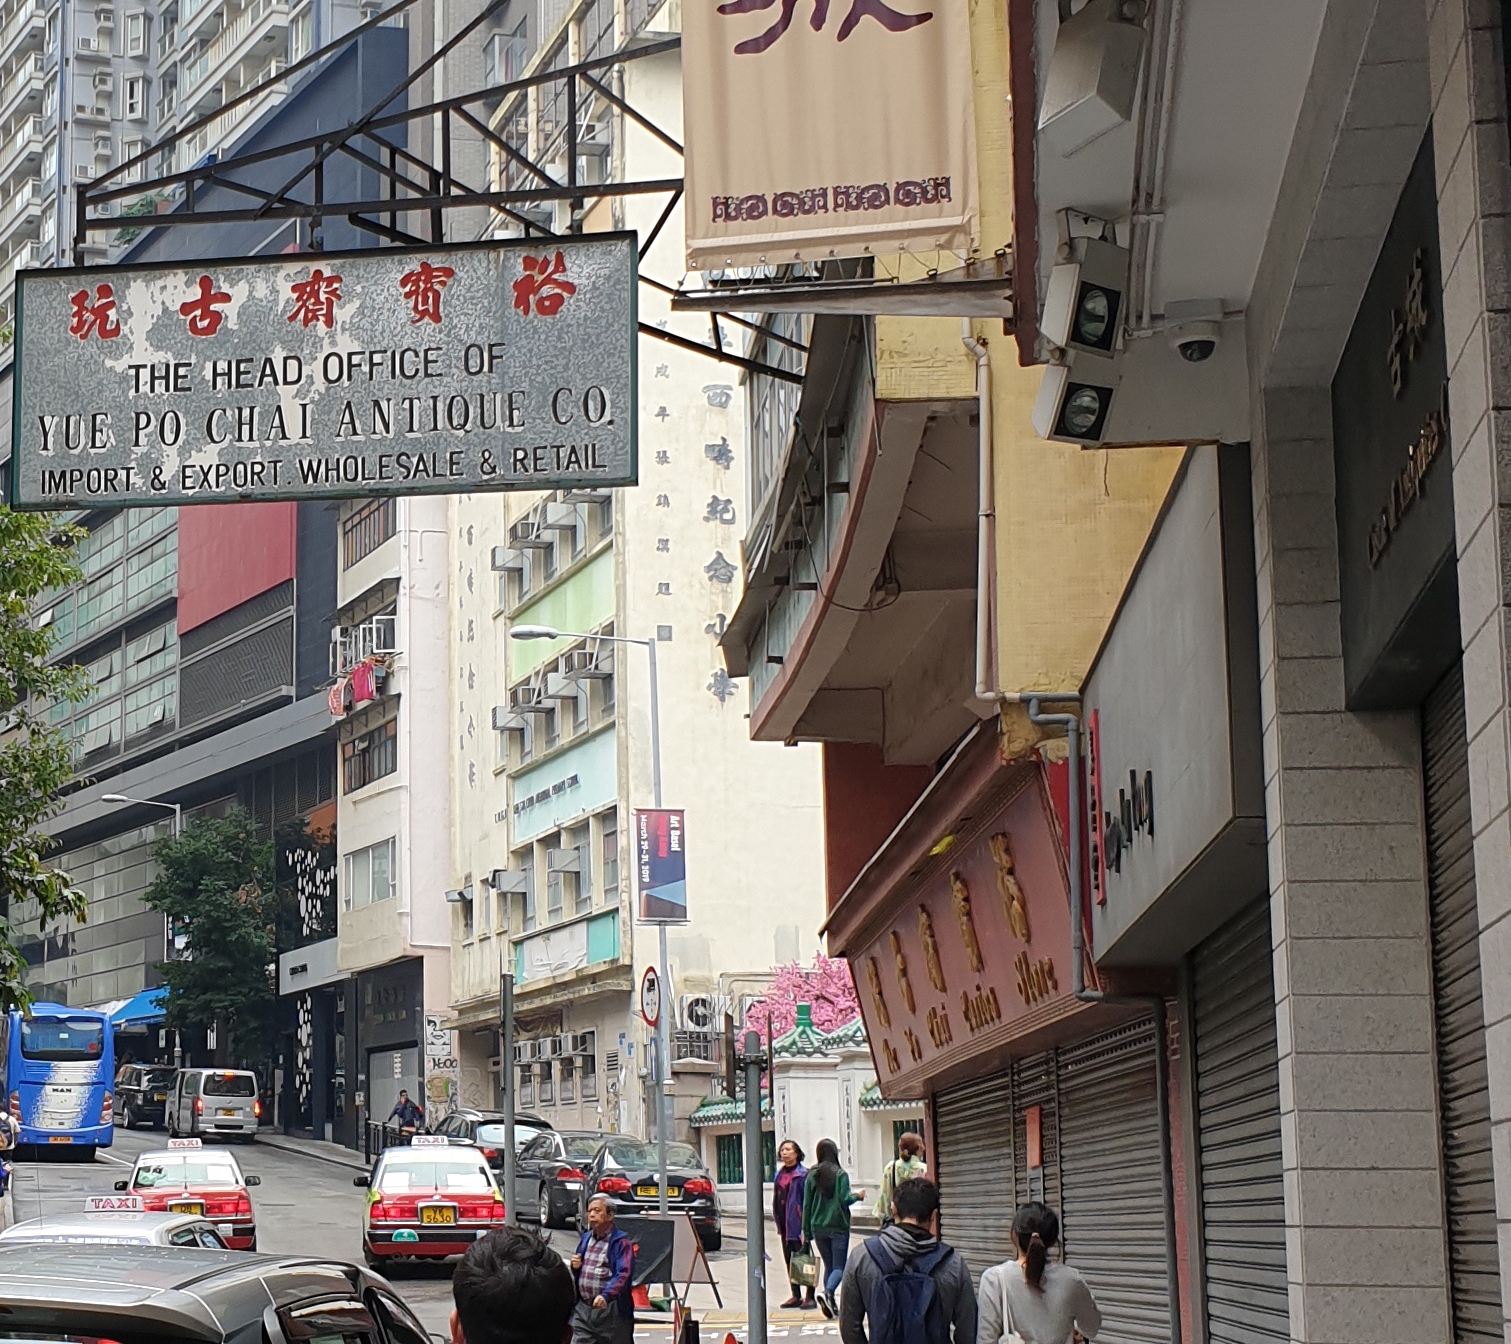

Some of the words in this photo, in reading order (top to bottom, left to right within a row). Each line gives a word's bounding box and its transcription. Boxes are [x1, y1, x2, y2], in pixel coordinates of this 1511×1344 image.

[127, 362, 192, 394] THE
[211, 356, 303, 391] HEAD
[322, 347, 443, 385] OFFICE
[464, 343, 506, 376] OF
[38, 411, 109, 452] YUE
[133, 409, 182, 448] PO
[206, 402, 311, 444] CHAI
[335, 390, 526, 438] ANTIQUE
[551, 385, 615, 426] CO.
[41, 466, 135, 495] IMPORT
[150, 465, 167, 492] &
[298, 451, 464, 485] WHOLESALE
[480, 448, 497, 476] &
[513, 443, 607, 473] RETAIL
[415, 1136, 445, 1144] TAXI
[91, 1198, 138, 1209] TAXI
